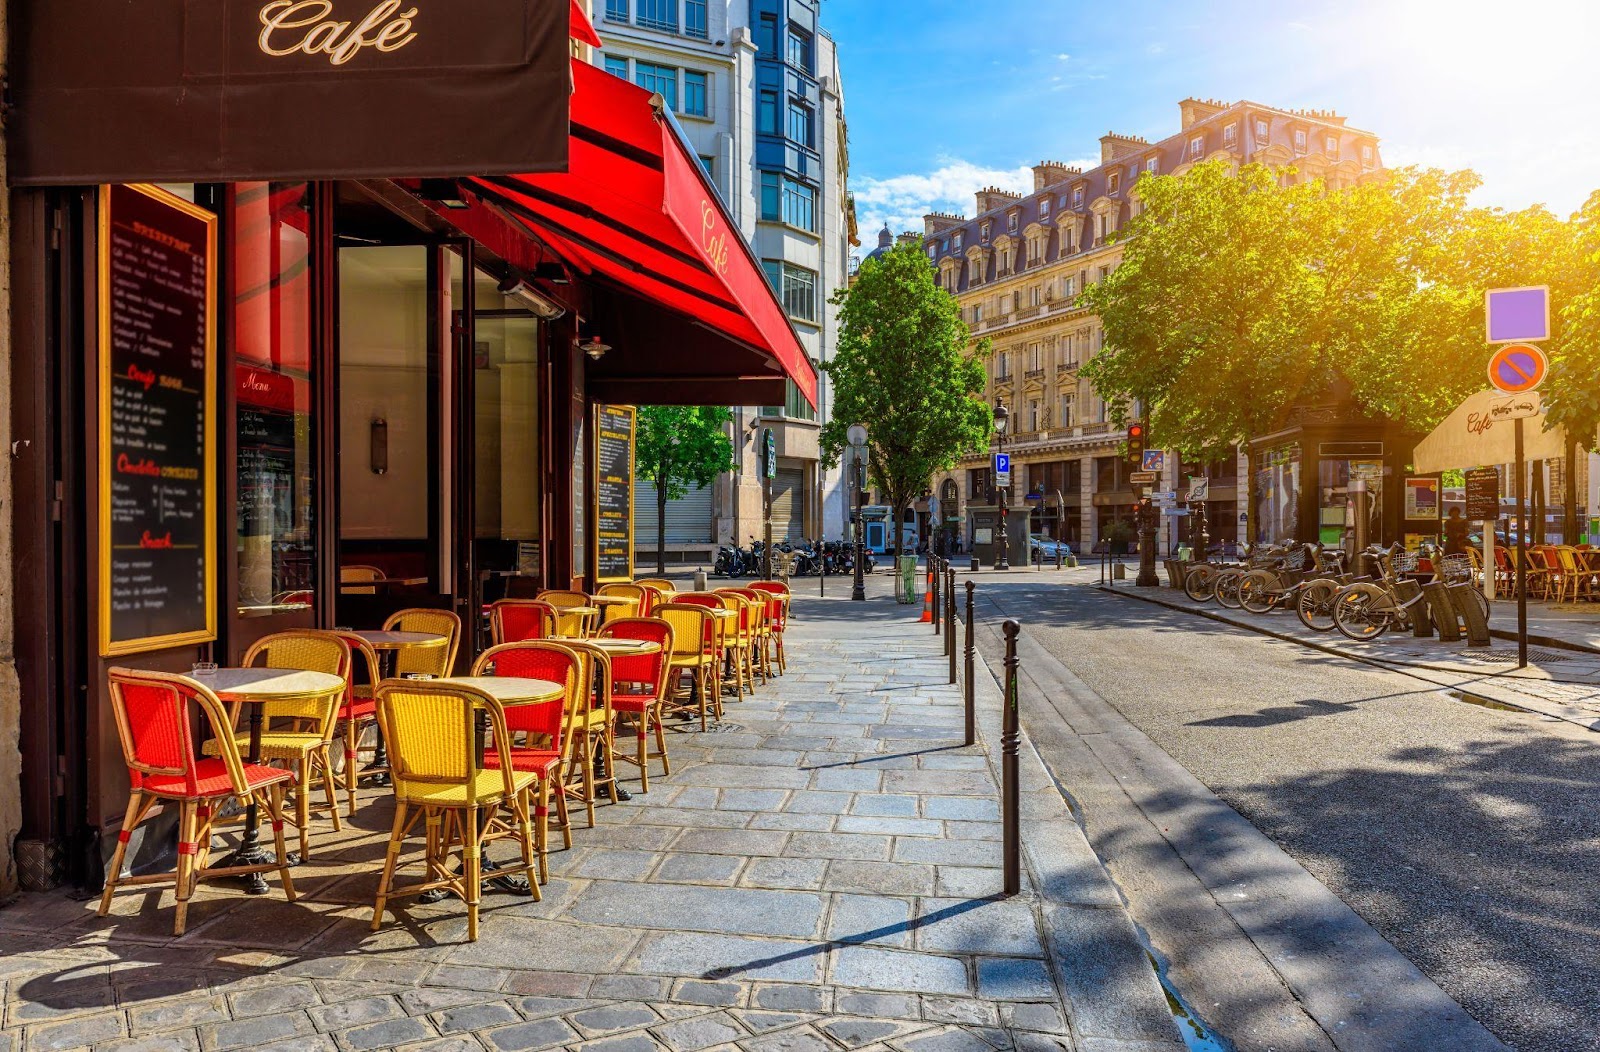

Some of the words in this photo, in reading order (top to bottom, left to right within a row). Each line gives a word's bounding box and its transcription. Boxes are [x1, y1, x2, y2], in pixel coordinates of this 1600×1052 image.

[258, 0, 419, 65] Café
[701, 199, 729, 275] Café
[242, 372, 270, 391] Menu
[1000, 457, 1006, 469] P
